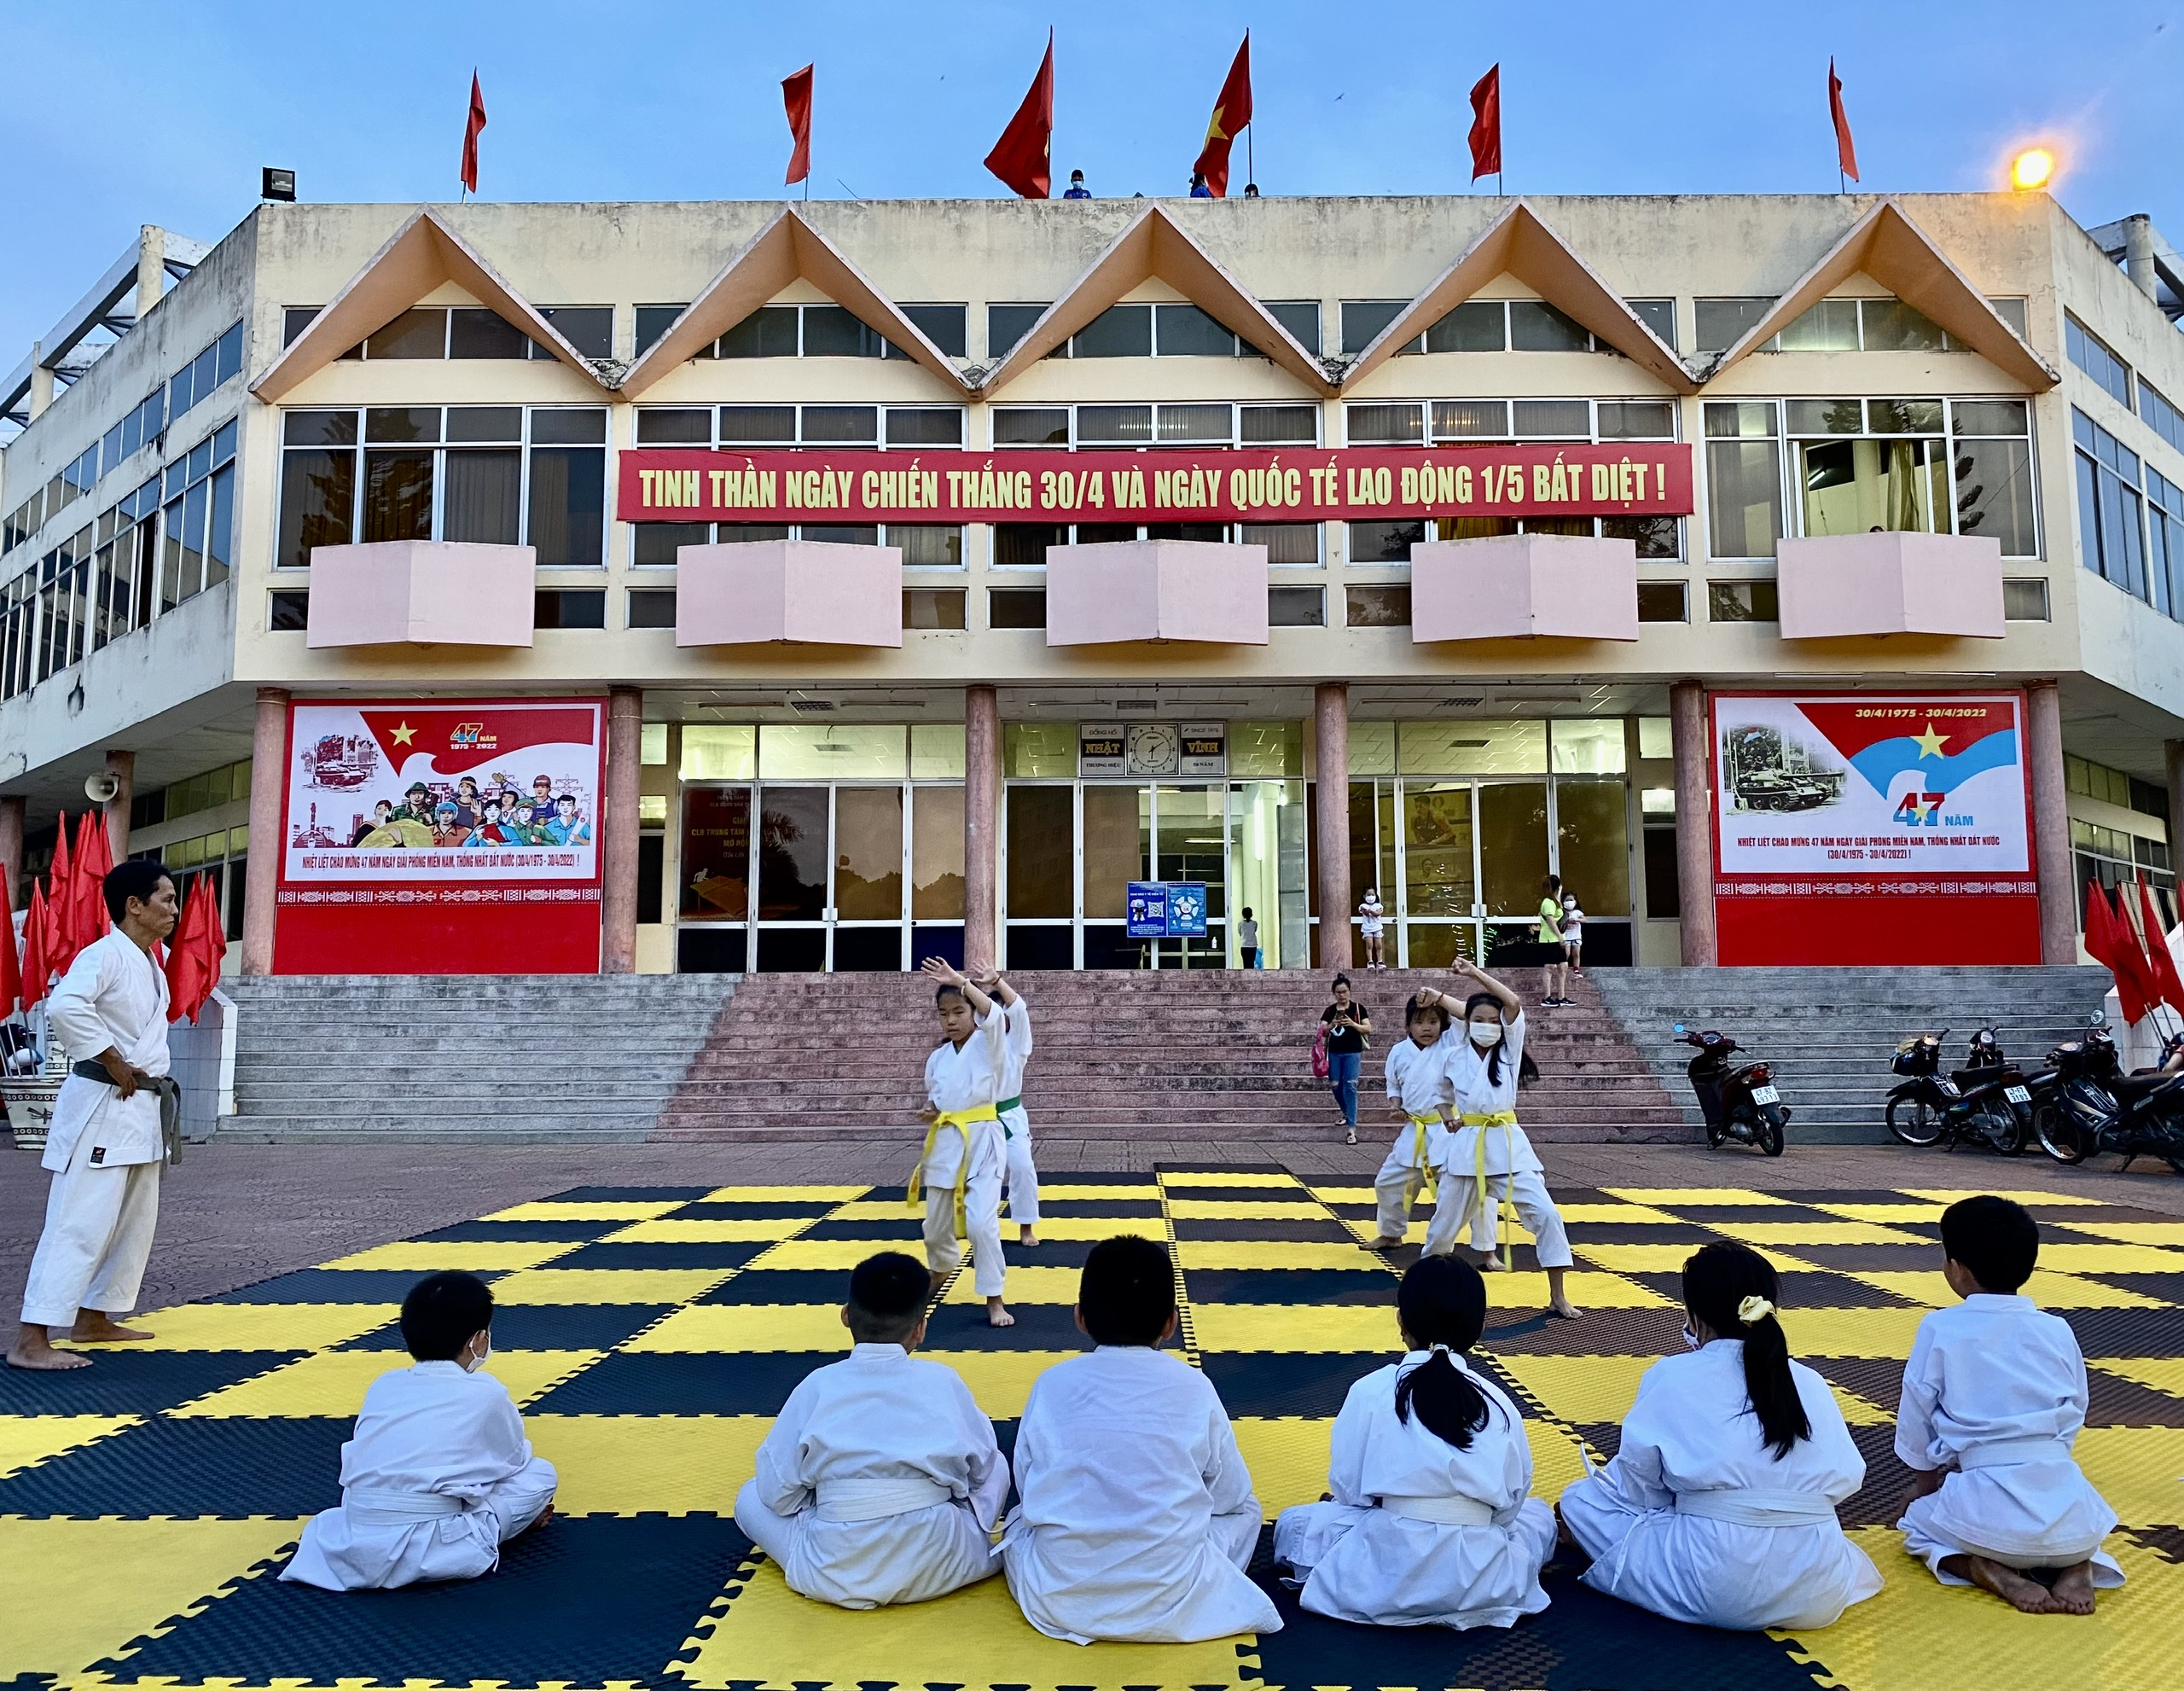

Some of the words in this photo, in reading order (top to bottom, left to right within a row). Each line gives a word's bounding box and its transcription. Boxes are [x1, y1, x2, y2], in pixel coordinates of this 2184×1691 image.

[638, 469, 700, 508] TINH
[708, 457, 776, 508] THẦN
[785, 464, 854, 508] NGÀY
[862, 457, 938, 509] CHIẾN
[945, 459, 1032, 509] THẮNG
[1040, 470, 1105, 509] 30/4
[1112, 464, 1148, 508] VÀ
[1154, 463, 1223, 508] NGÀY
[1229, 455, 1301, 511] QUỐC
[1309, 455, 1339, 506] TẾ
[1346, 467, 1392, 506] LAO
[1400, 459, 1473, 512] ĐỘNG
[1480, 464, 1525, 503] 1/5
[1532, 450, 1583, 502] BẤT
[1591, 456, 1648, 508] DIỆT
[1855, 708, 1917, 718] 30/4/1975
[1925, 708, 1987, 718] 30/4/2022
[450, 723, 484, 742] 47
[1085, 741, 1121, 756] NHẬT
[1892, 792, 1946, 827] 47
[1944, 813, 1974, 827] NĂM
[1737, 836, 1756, 849] NHIỆT
[1757, 836, 1770, 849] LIỆT
[1772, 835, 1789, 847] CHÀO
[1791, 835, 1809, 847] MỪNG
[1811, 837, 1819, 846] 47
[1821, 836, 1835, 847] NĂM
[1836, 835, 1853, 846] NGÀY
[1855, 835, 1867, 846] GIẢI
[1869, 835, 1891, 846] PHÓNG
[1910, 836, 1926, 847] NAM,
[1927, 834, 1949, 846] THỐNG
[1949, 834, 1966, 846] NHẤT
[1982, 835, 2001, 846] NƯỚC
[302, 853, 317, 871] NHIỆT
[317, 853, 329, 871] LIỆT
[329, 853, 344, 869] CHÀO
[361, 856, 368, 869] 47
[368, 853, 381, 869] NĂM
[381, 853, 396, 869] NGÀY
[456, 851, 473, 868] THỐNG
[474, 851, 489, 868] NHẤT
